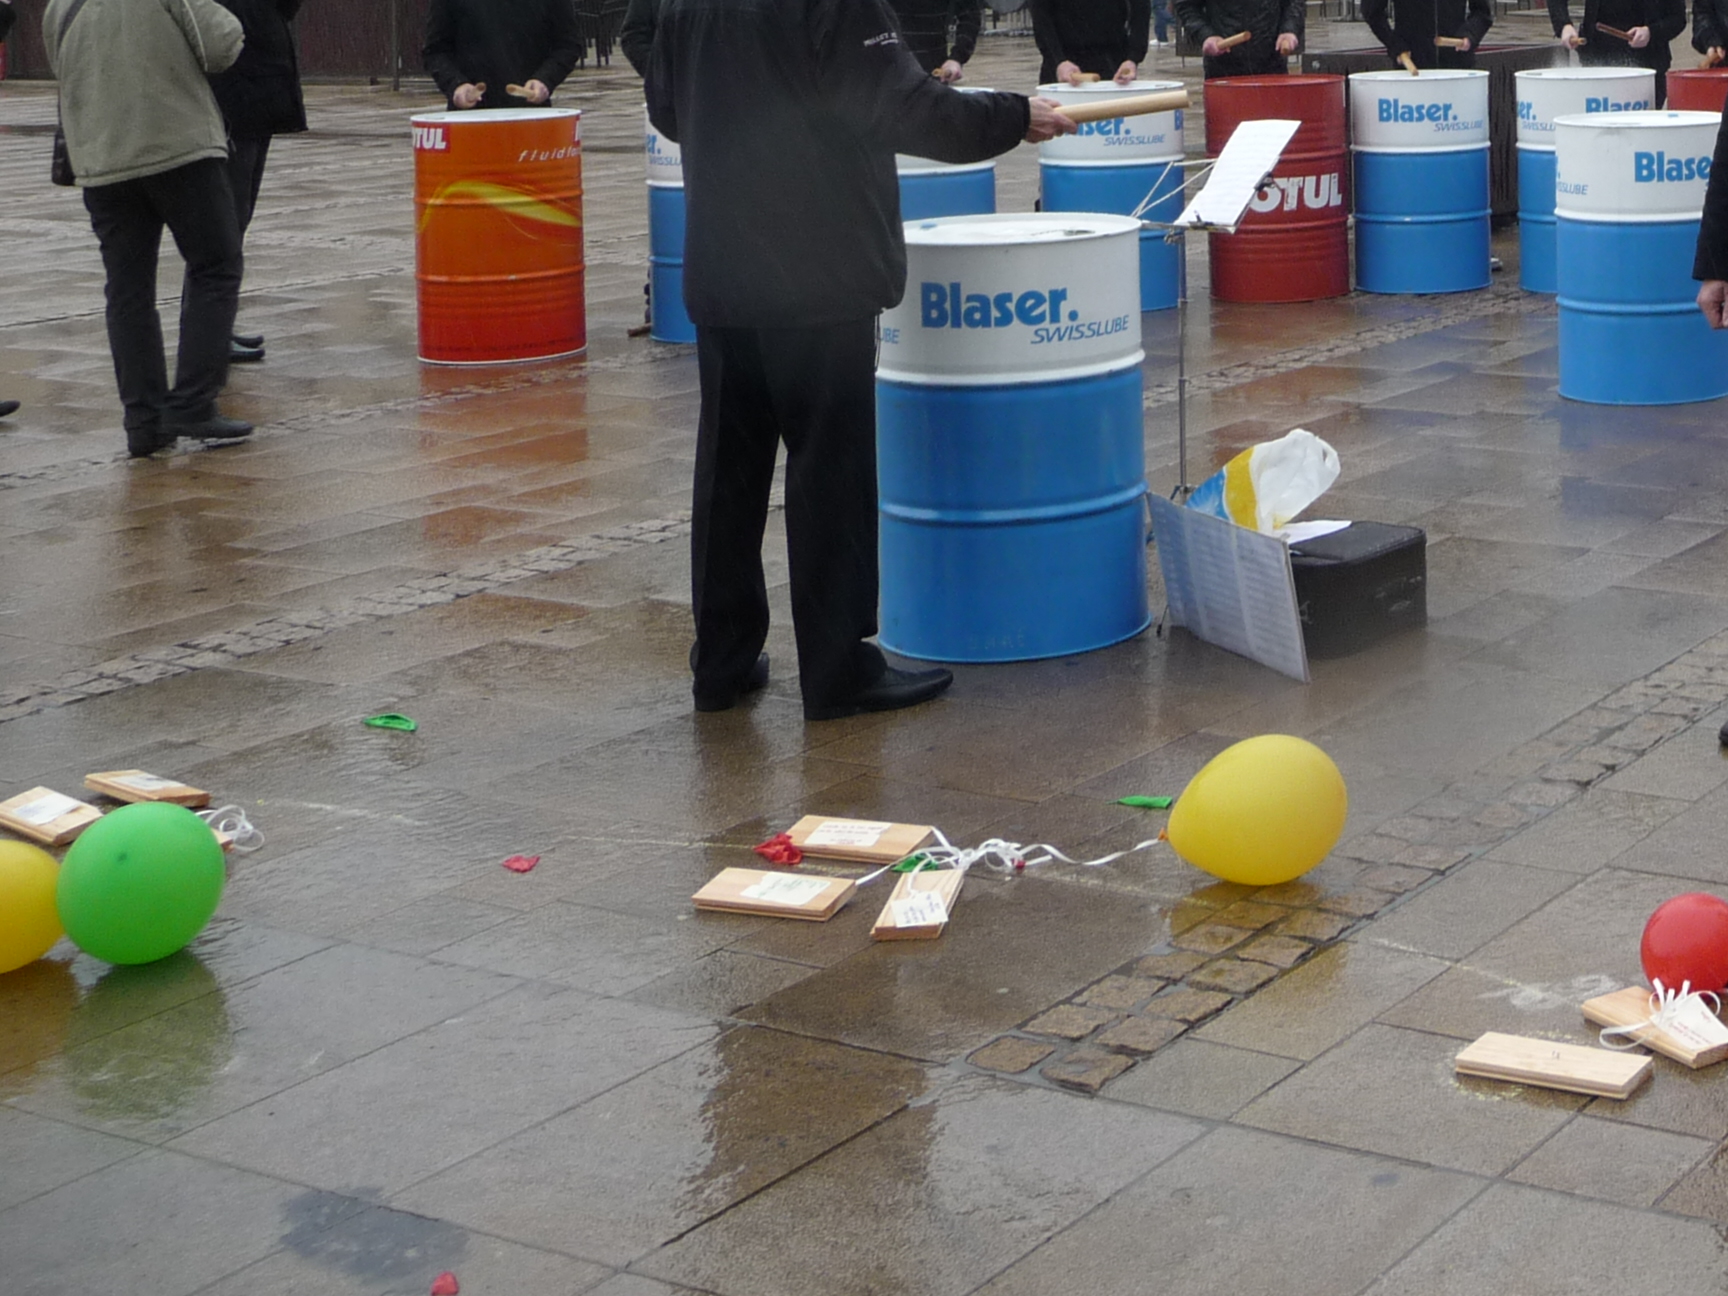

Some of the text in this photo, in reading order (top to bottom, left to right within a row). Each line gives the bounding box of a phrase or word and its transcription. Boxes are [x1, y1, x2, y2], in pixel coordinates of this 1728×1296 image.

[1378, 98, 1458, 123] Blaser.
[1433, 119, 1484, 132] SWISSLUBE
[412, 127, 447, 150] TUL
[1103, 133, 1166, 147] SWISSLUBE
[1250, 172, 1343, 213] OTUL
[920, 281, 1079, 329] Blaser.
[1030, 315, 1130, 345] SWISSLUBE
